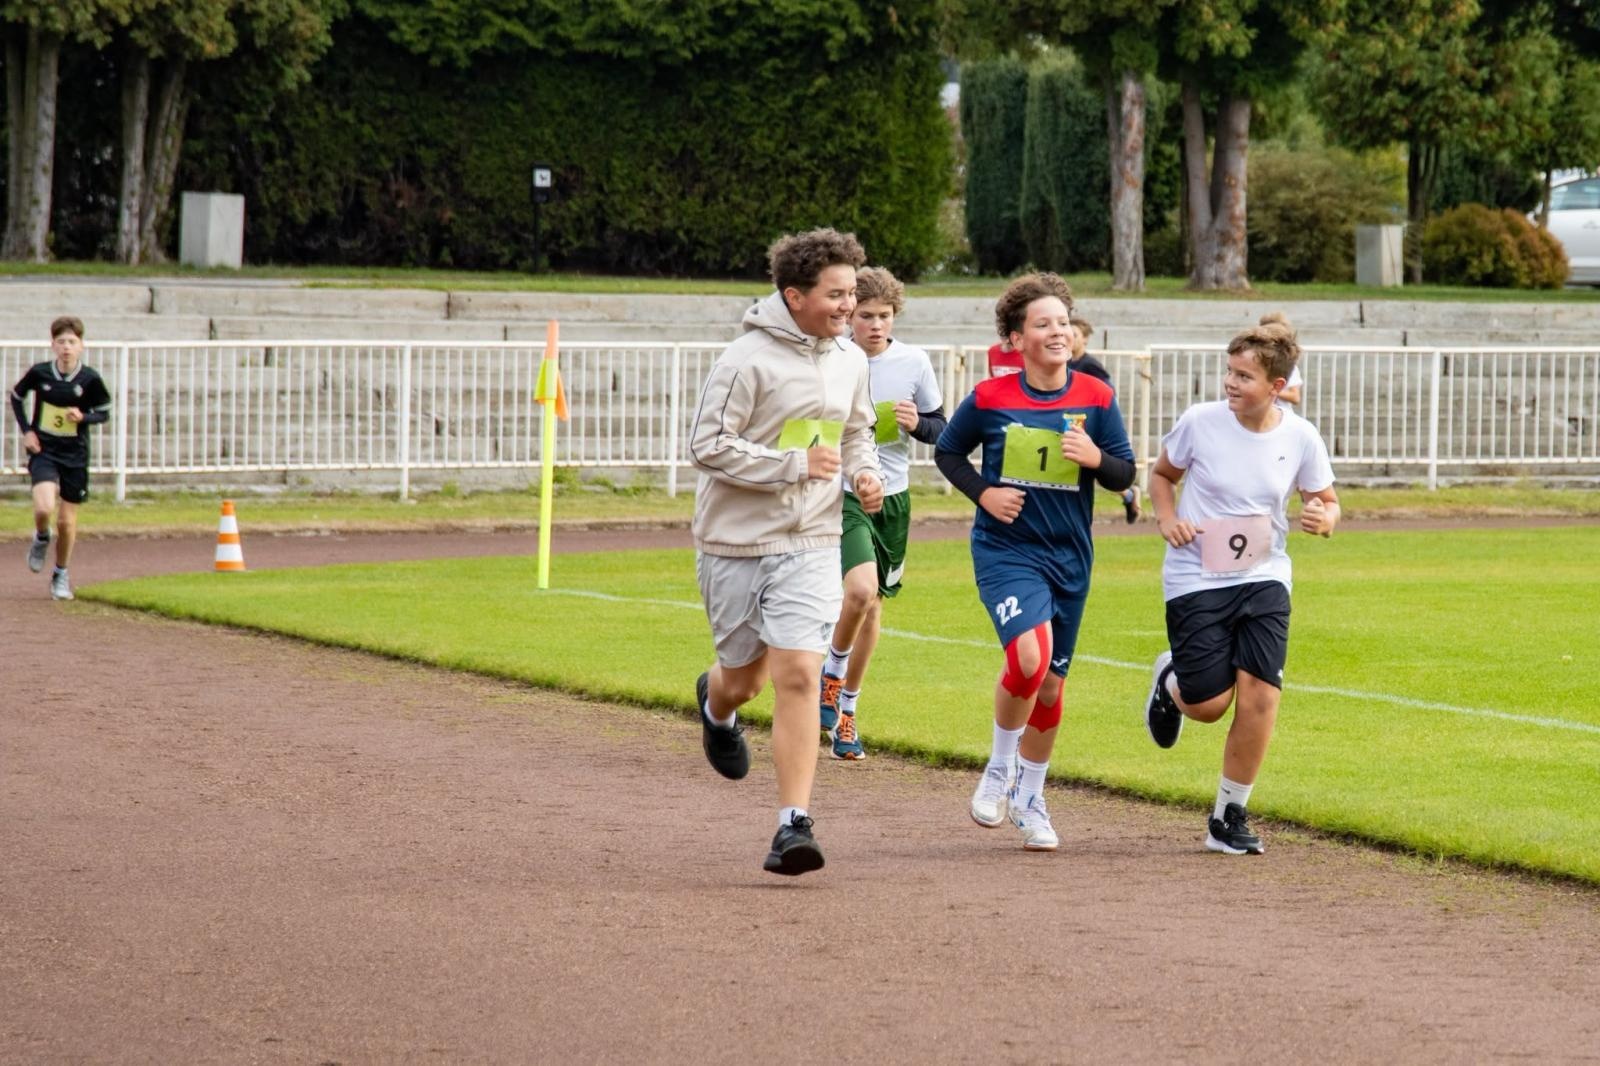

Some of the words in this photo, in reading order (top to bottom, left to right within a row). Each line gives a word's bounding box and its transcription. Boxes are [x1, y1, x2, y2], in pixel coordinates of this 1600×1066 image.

[54, 415, 63, 428] 3
[1036, 446, 1049, 472] 1
[996, 595, 1023, 626] 22
